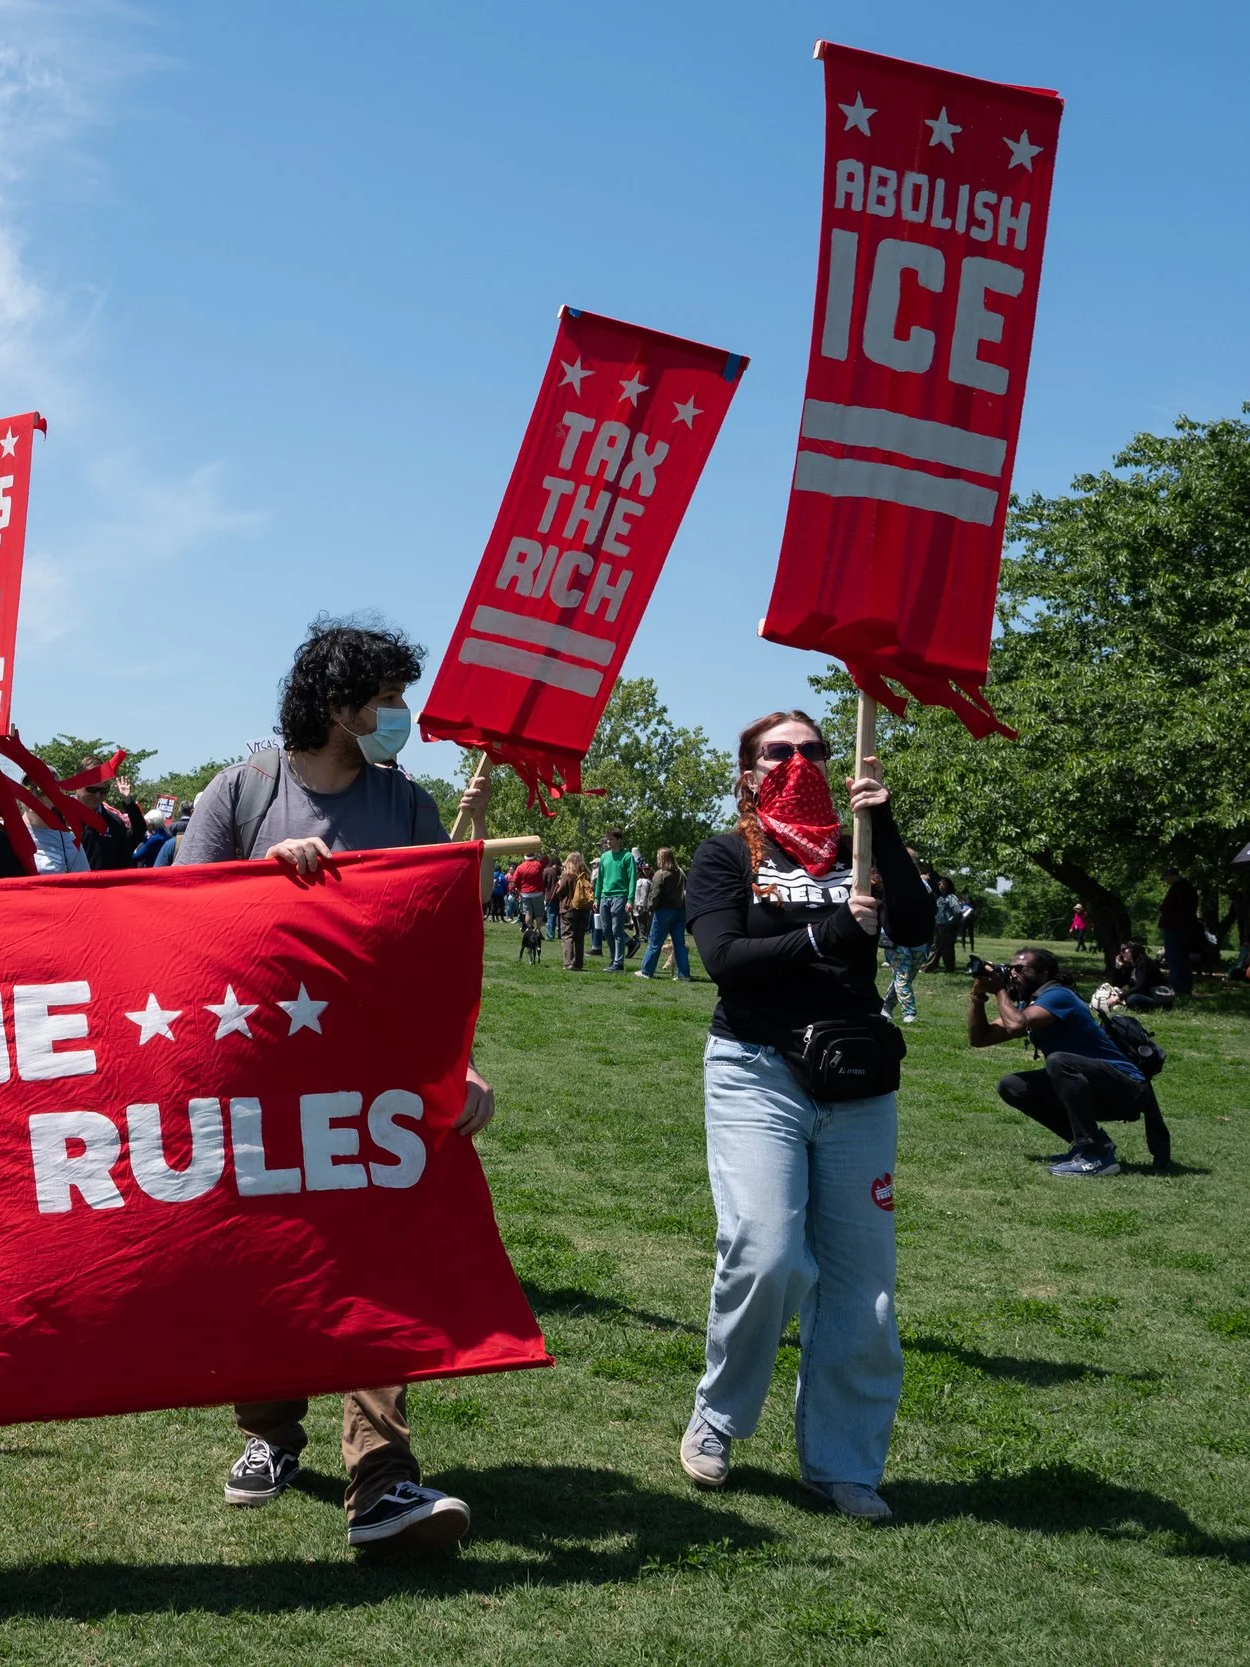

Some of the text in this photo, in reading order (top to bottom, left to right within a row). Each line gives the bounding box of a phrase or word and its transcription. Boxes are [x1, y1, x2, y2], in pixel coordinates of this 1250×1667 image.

[834, 158, 1031, 251] ABOLISH
[821, 228, 1025, 396] ICE
[558, 410, 670, 498] TAX
[537, 475, 646, 558] THE
[495, 536, 634, 623] RICH
[29, 1089, 427, 1214] RULES
